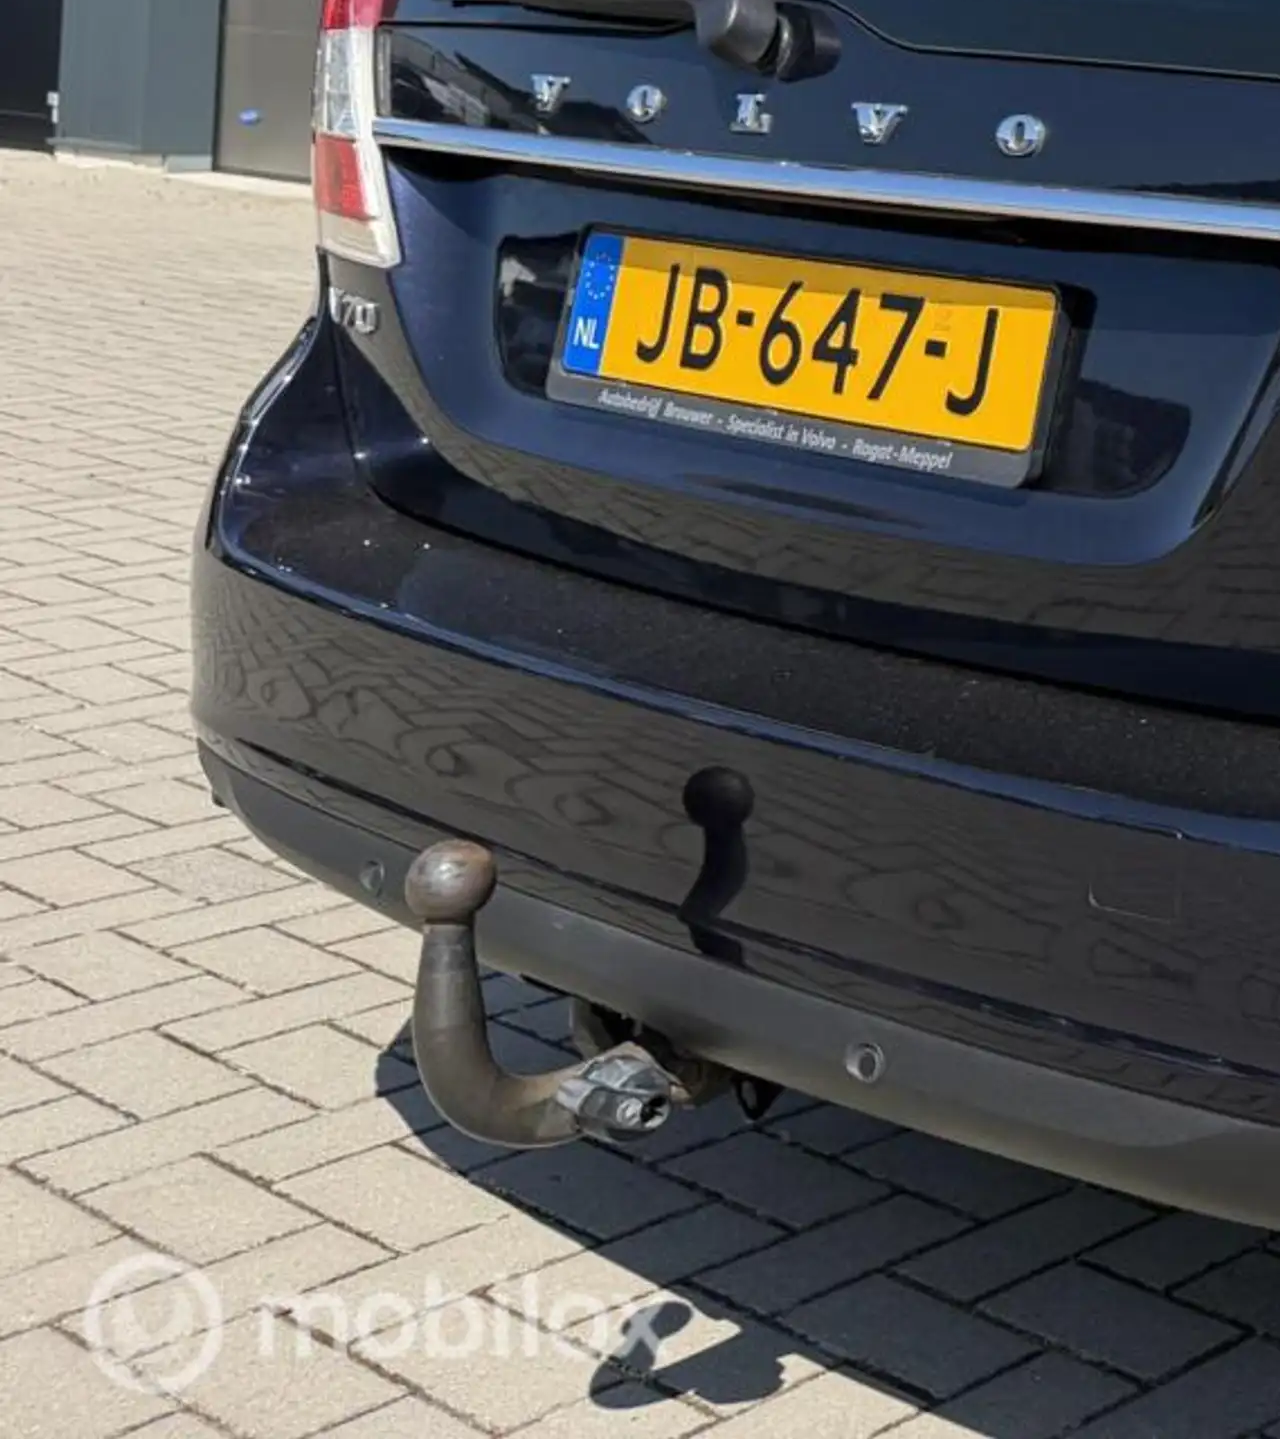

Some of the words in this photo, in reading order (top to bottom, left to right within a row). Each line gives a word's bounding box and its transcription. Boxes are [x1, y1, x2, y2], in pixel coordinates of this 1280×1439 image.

[530, 72, 1048, 159] VOLVO
[573, 315, 602, 352] NL
[635, 262, 1000, 418] JB-647-J
[598, 389, 661, 419] Autobedrijf
[664, 401, 714, 426] Brouwer
[726, 414, 786, 441] Specialist
[786, 423, 799, 441] in
[802, 427, 837, 451] Volvo
